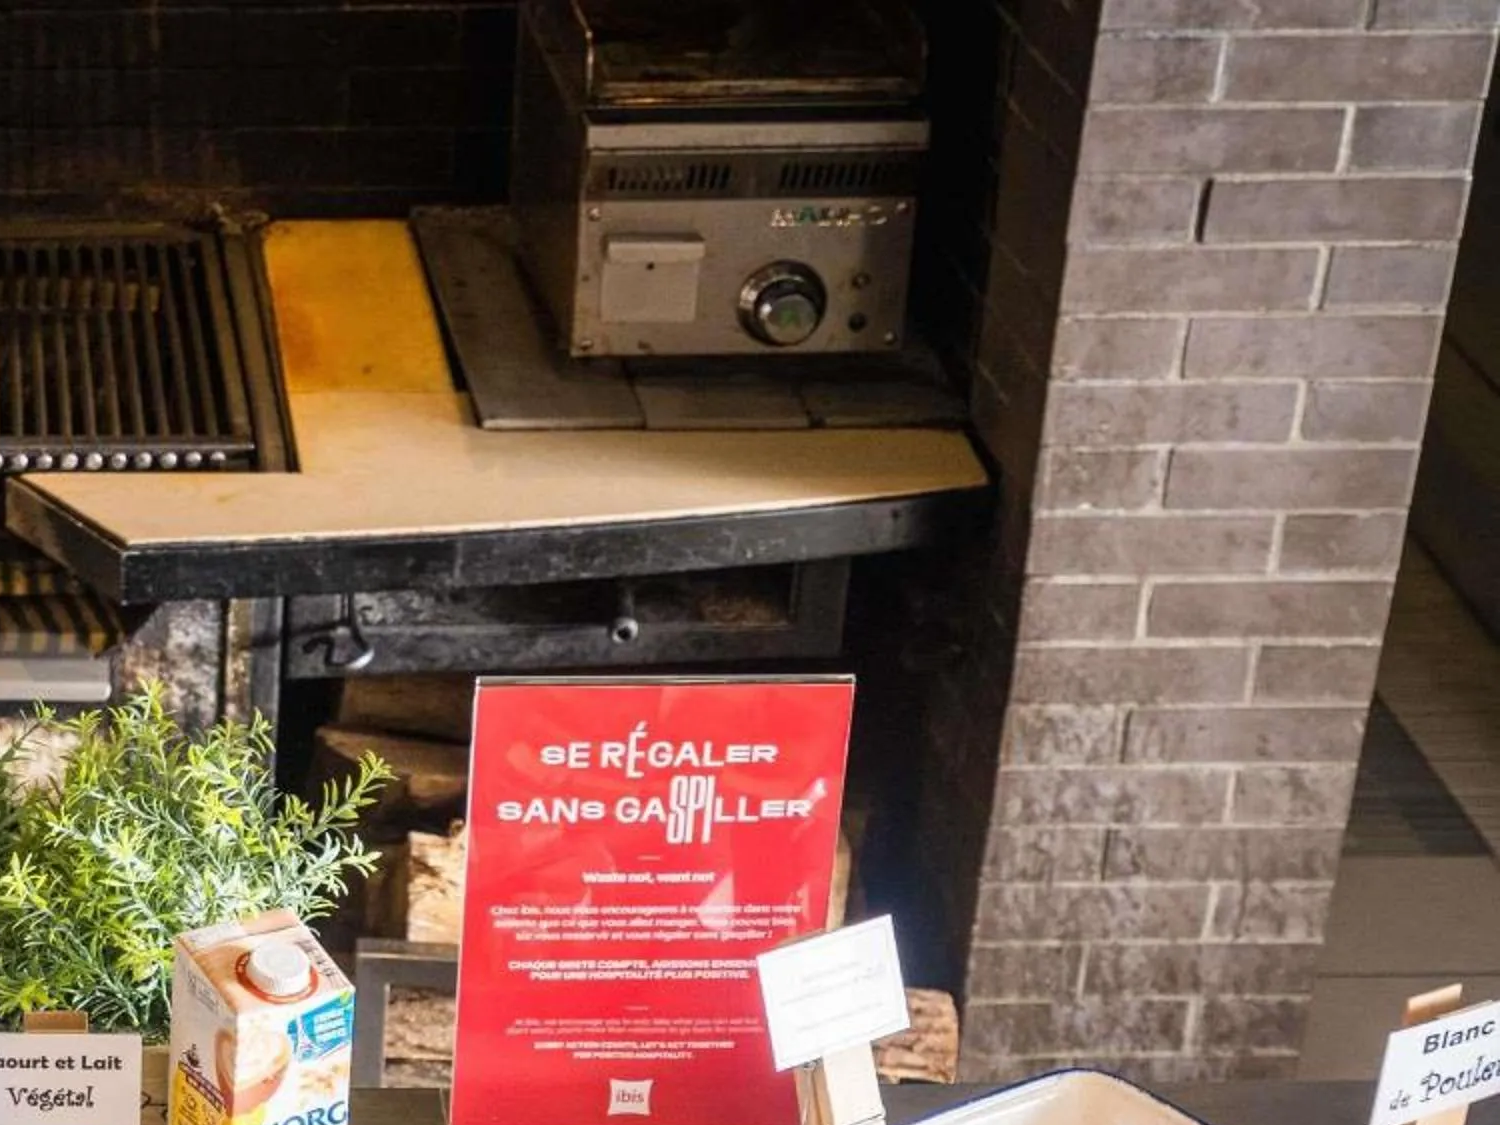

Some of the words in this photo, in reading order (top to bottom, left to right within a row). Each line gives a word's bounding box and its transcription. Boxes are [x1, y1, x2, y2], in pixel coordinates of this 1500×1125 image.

[540, 742, 590, 768] SE
[600, 721, 779, 778] RÉGALER
[497, 797, 605, 823] SANS
[615, 775, 815, 844] GASPILLER
[1422, 1020, 1496, 1055] Blanc
[55, 1056, 76, 1070] et
[81, 1055, 123, 1071] Lait
[6, 1085, 95, 1112] Végétal
[615, 1090, 645, 1104] ibis
[1388, 1089, 1412, 1111] de
